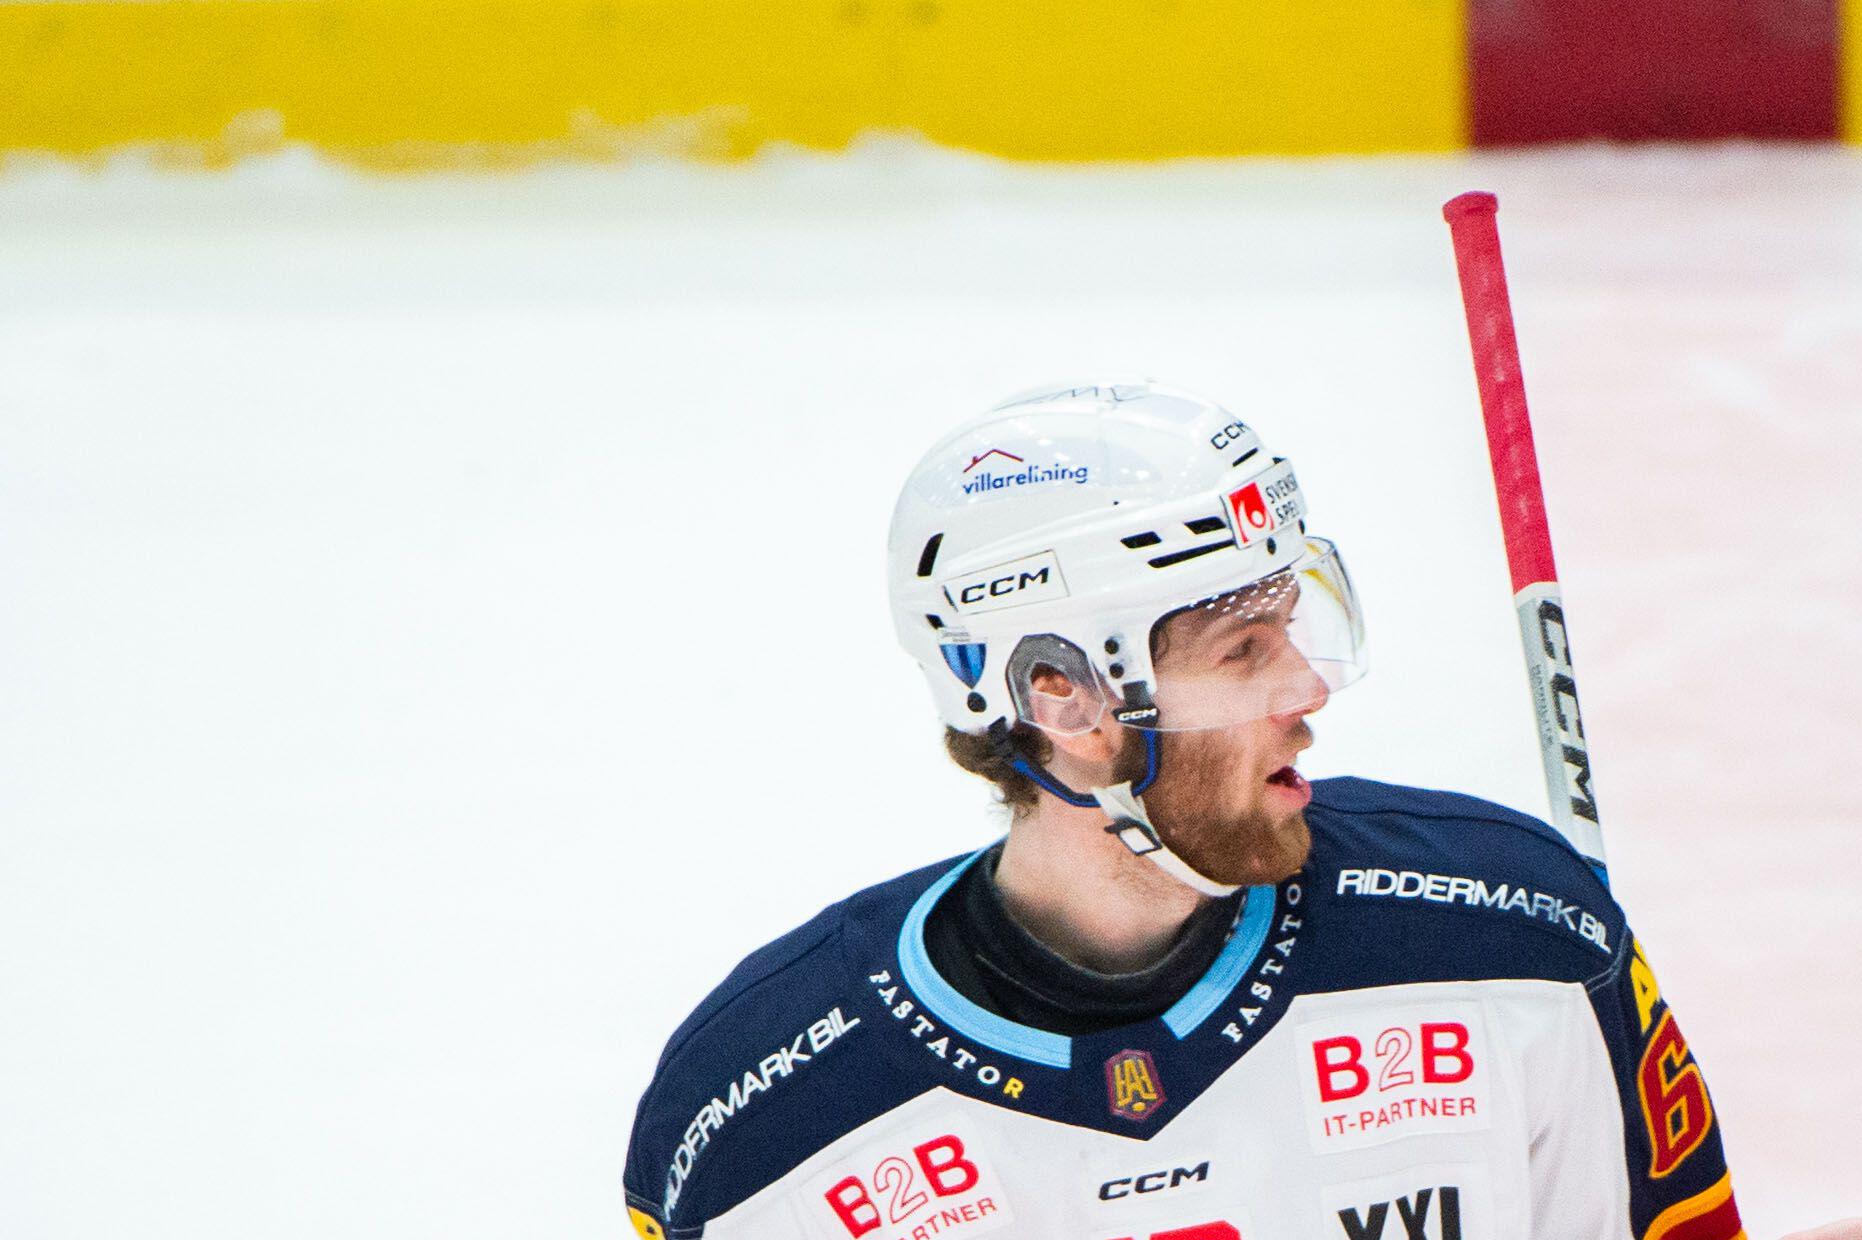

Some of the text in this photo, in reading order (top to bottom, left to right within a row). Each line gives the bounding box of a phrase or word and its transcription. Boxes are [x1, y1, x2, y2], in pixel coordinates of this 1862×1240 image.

[962, 464, 1089, 494] villarelining
[961, 566, 1050, 605] CCM
[1117, 708, 1158, 721] CCM
[1538, 599, 1600, 825] CCM
[1336, 868, 1612, 954] RIDDERMARK BIL
[1221, 883, 1302, 1043] FASTATO
[806, 1007, 861, 1053] BIL
[1310, 1021, 1476, 1104] B2B
[1323, 1096, 1477, 1137] IT-PARTNER
[824, 1133, 980, 1240] B2B
[1098, 1160, 1211, 1201] CCM
